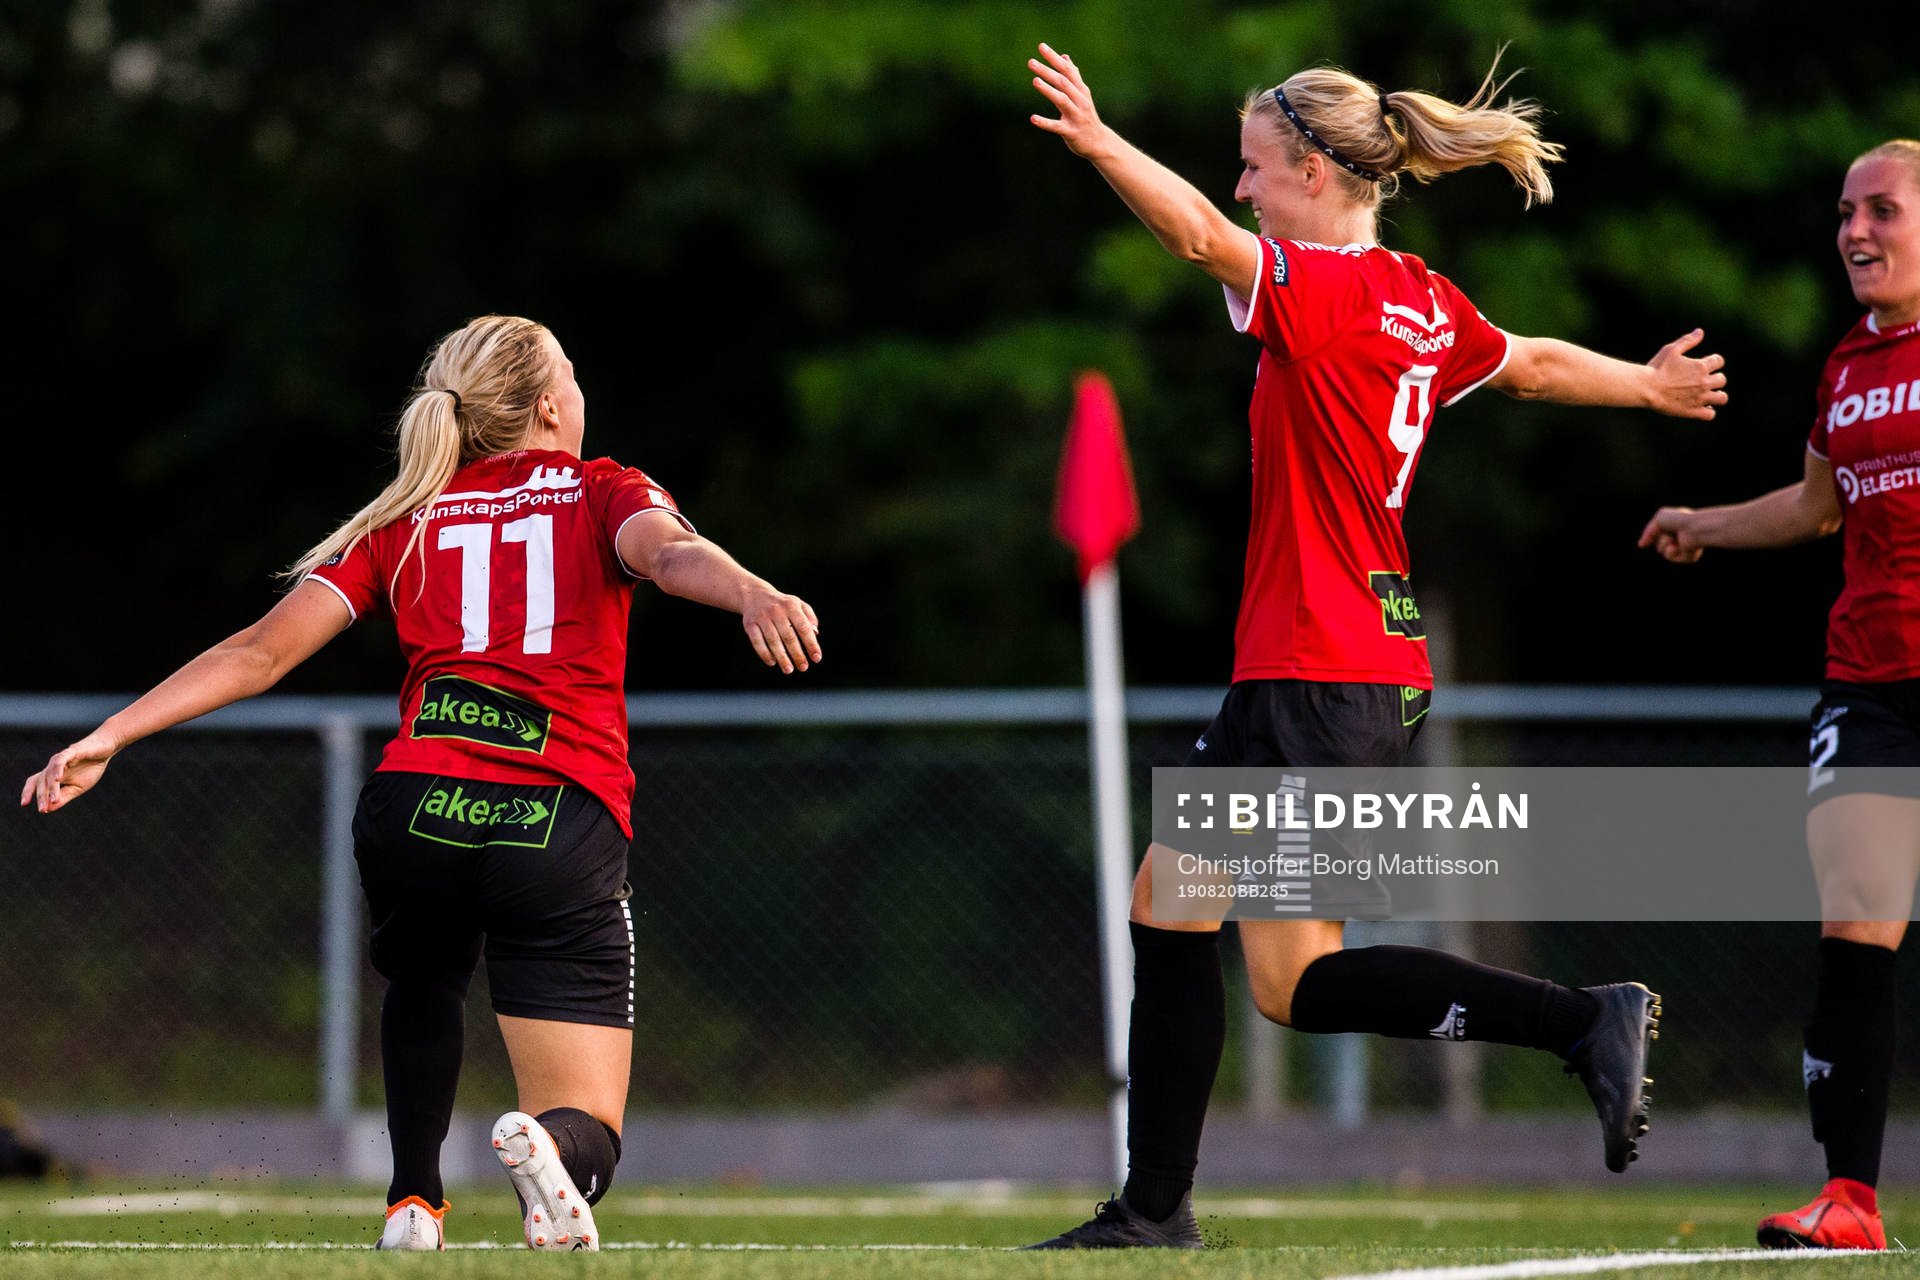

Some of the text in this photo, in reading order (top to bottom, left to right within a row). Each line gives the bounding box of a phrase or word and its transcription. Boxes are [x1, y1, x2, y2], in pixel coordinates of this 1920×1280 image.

[1385, 364, 1438, 508] 9
[438, 514, 554, 654] 11
[420, 693, 500, 728] akea
[425, 786, 509, 826] akea
